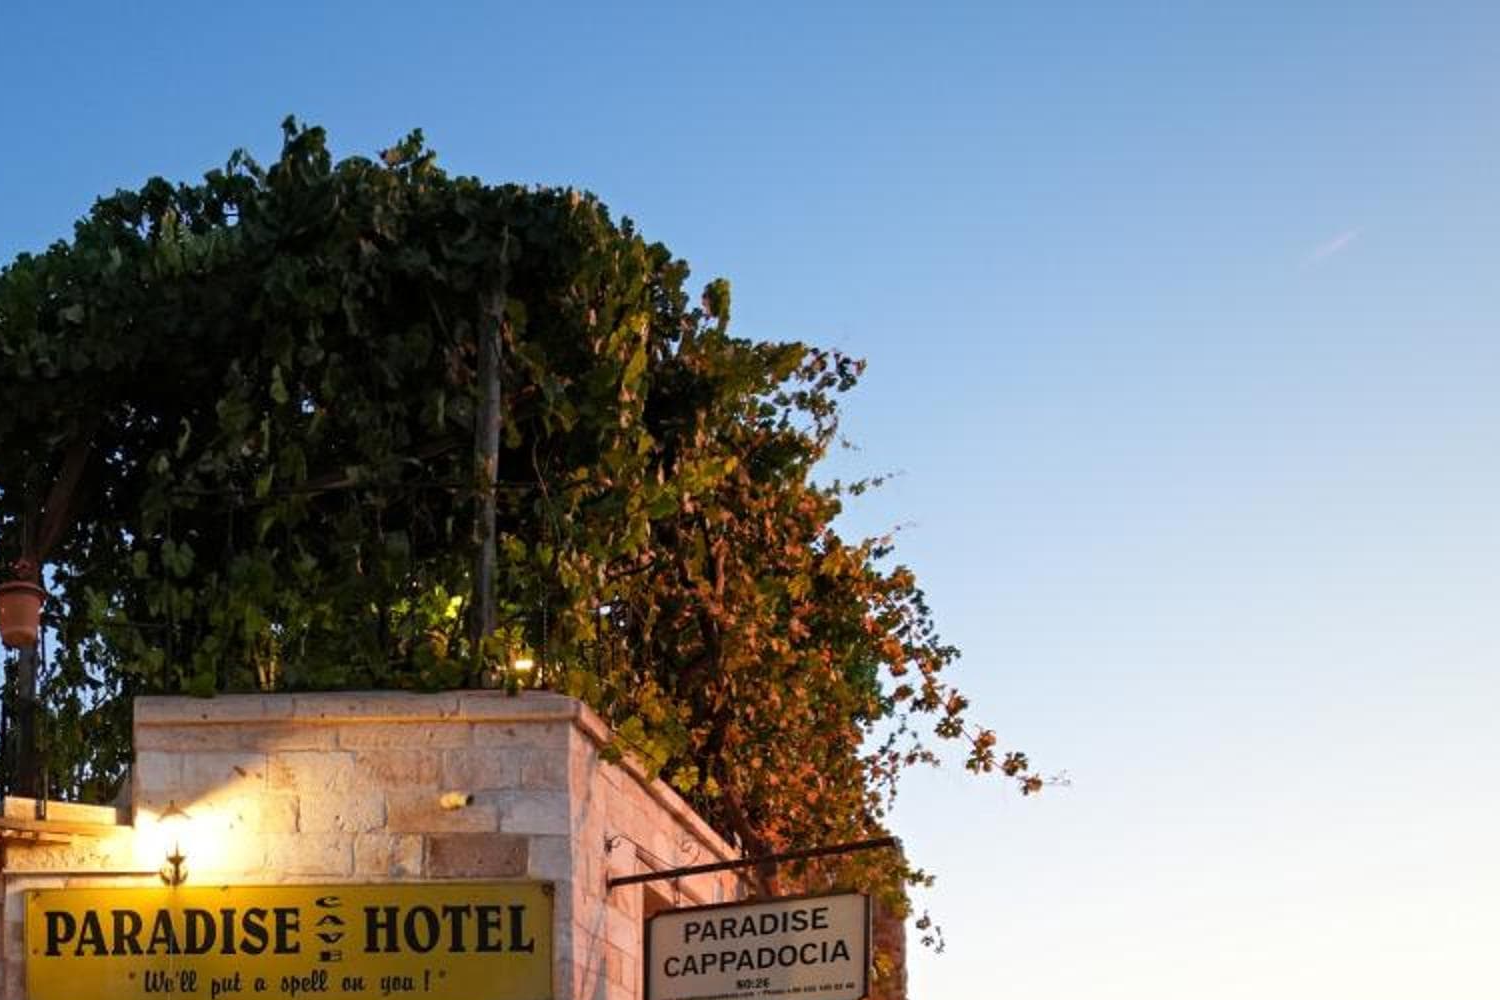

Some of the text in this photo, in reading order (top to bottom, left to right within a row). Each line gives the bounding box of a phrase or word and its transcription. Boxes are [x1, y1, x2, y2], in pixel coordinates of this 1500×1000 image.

[43, 895, 536, 962] PARADISE CAVE HOTEL
[683, 907, 829, 944] PARADISE
[663, 939, 851, 978] CAPPADOCIA
[211, 971, 242, 999] put
[254, 977, 268, 993] a
[280, 970, 329, 998] spell
[342, 976, 366, 993] on
